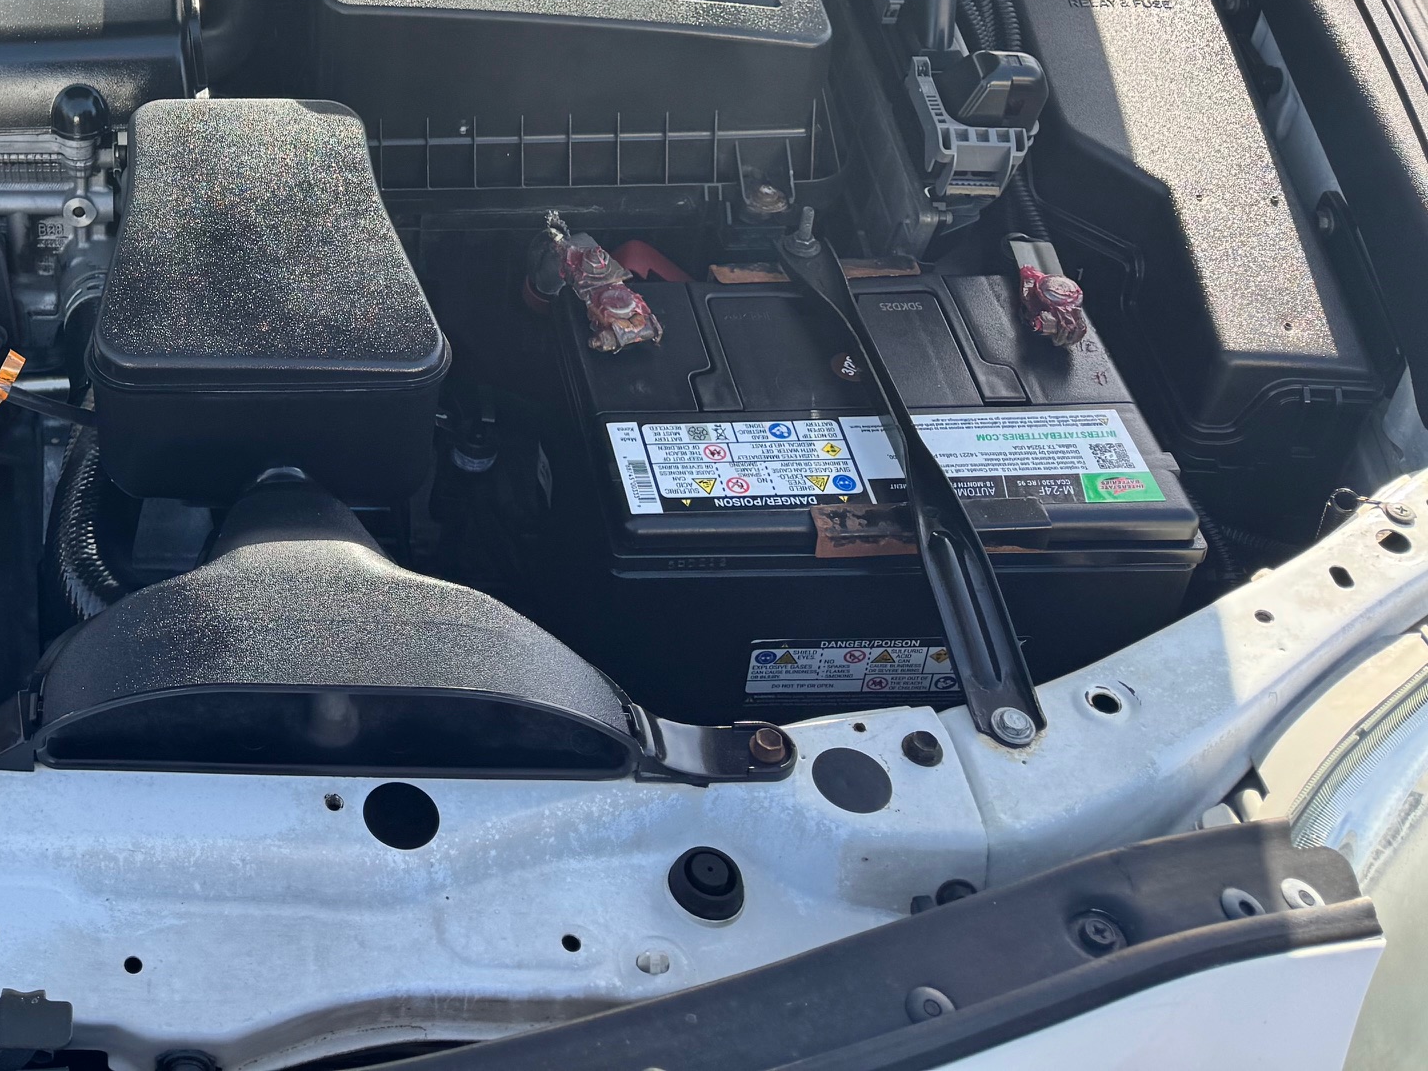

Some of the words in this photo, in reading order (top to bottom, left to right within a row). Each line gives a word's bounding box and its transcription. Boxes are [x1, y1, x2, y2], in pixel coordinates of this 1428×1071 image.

[976, 430, 1117, 441] INTERSTATEBATTERIES.COM
[1039, 486, 1074, 495] M-24F
[714, 496, 817, 507] DANGER/POISON
[820, 640, 920, 648] DANGER/POISON
